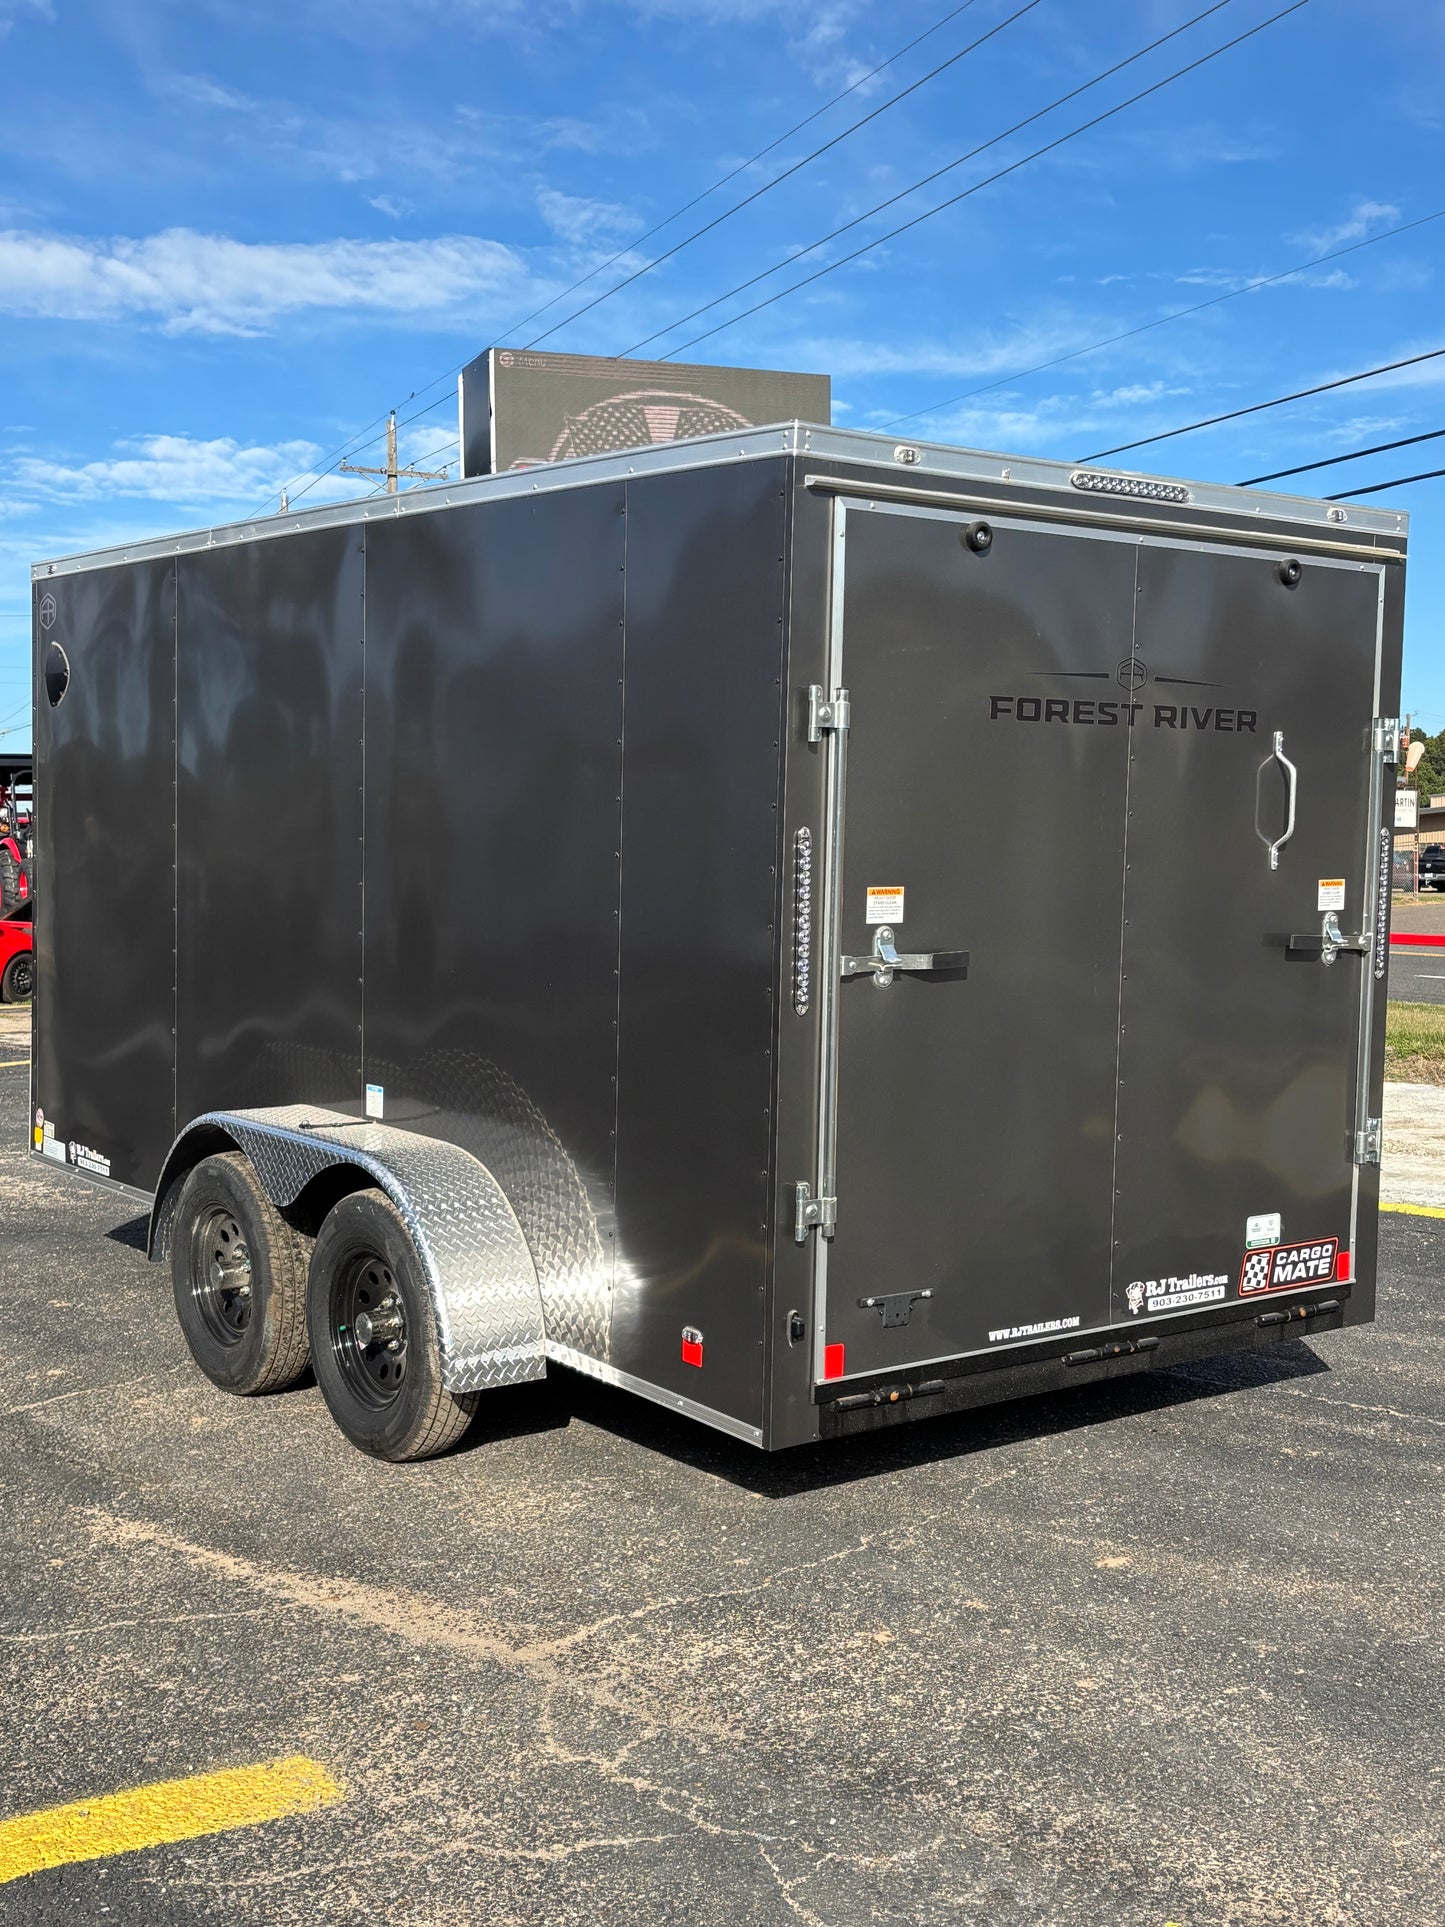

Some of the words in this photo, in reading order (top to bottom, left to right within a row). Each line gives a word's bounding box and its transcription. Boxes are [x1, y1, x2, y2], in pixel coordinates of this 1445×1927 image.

[989, 695, 1144, 727] FOREST
[1153, 704, 1258, 733] RIVER
[1276, 1244, 1333, 1265] CARGO
[1272, 1257, 1331, 1284] MATE
[1145, 1279, 1167, 1297] RJ
[1152, 1289, 1222, 1307] 903-230-7511
[988, 1316, 1080, 1342] WWW.RJTRAILERS.COM
